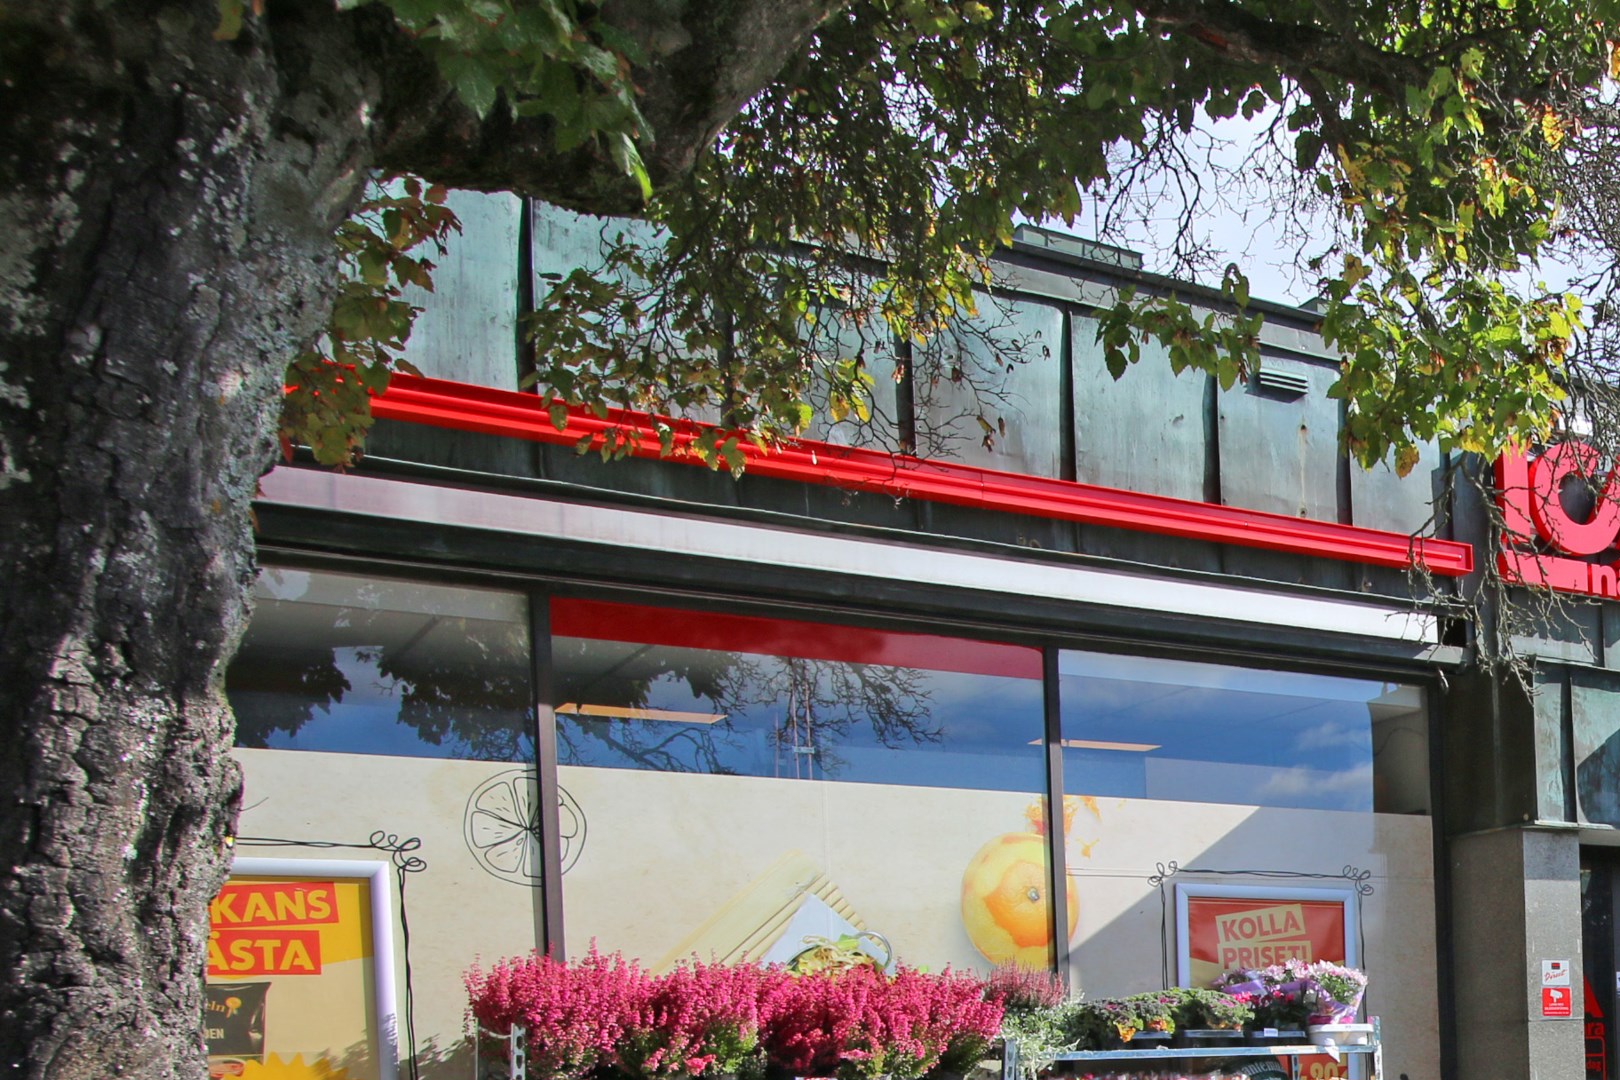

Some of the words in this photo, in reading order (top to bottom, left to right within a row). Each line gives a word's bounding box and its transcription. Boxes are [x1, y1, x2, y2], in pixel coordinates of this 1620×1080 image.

[210, 889, 331, 924] KANS
[1222, 911, 1300, 942] KOLLA
[207, 931, 315, 971] ÄSTA
[1223, 944, 1308, 970] PRISET!
